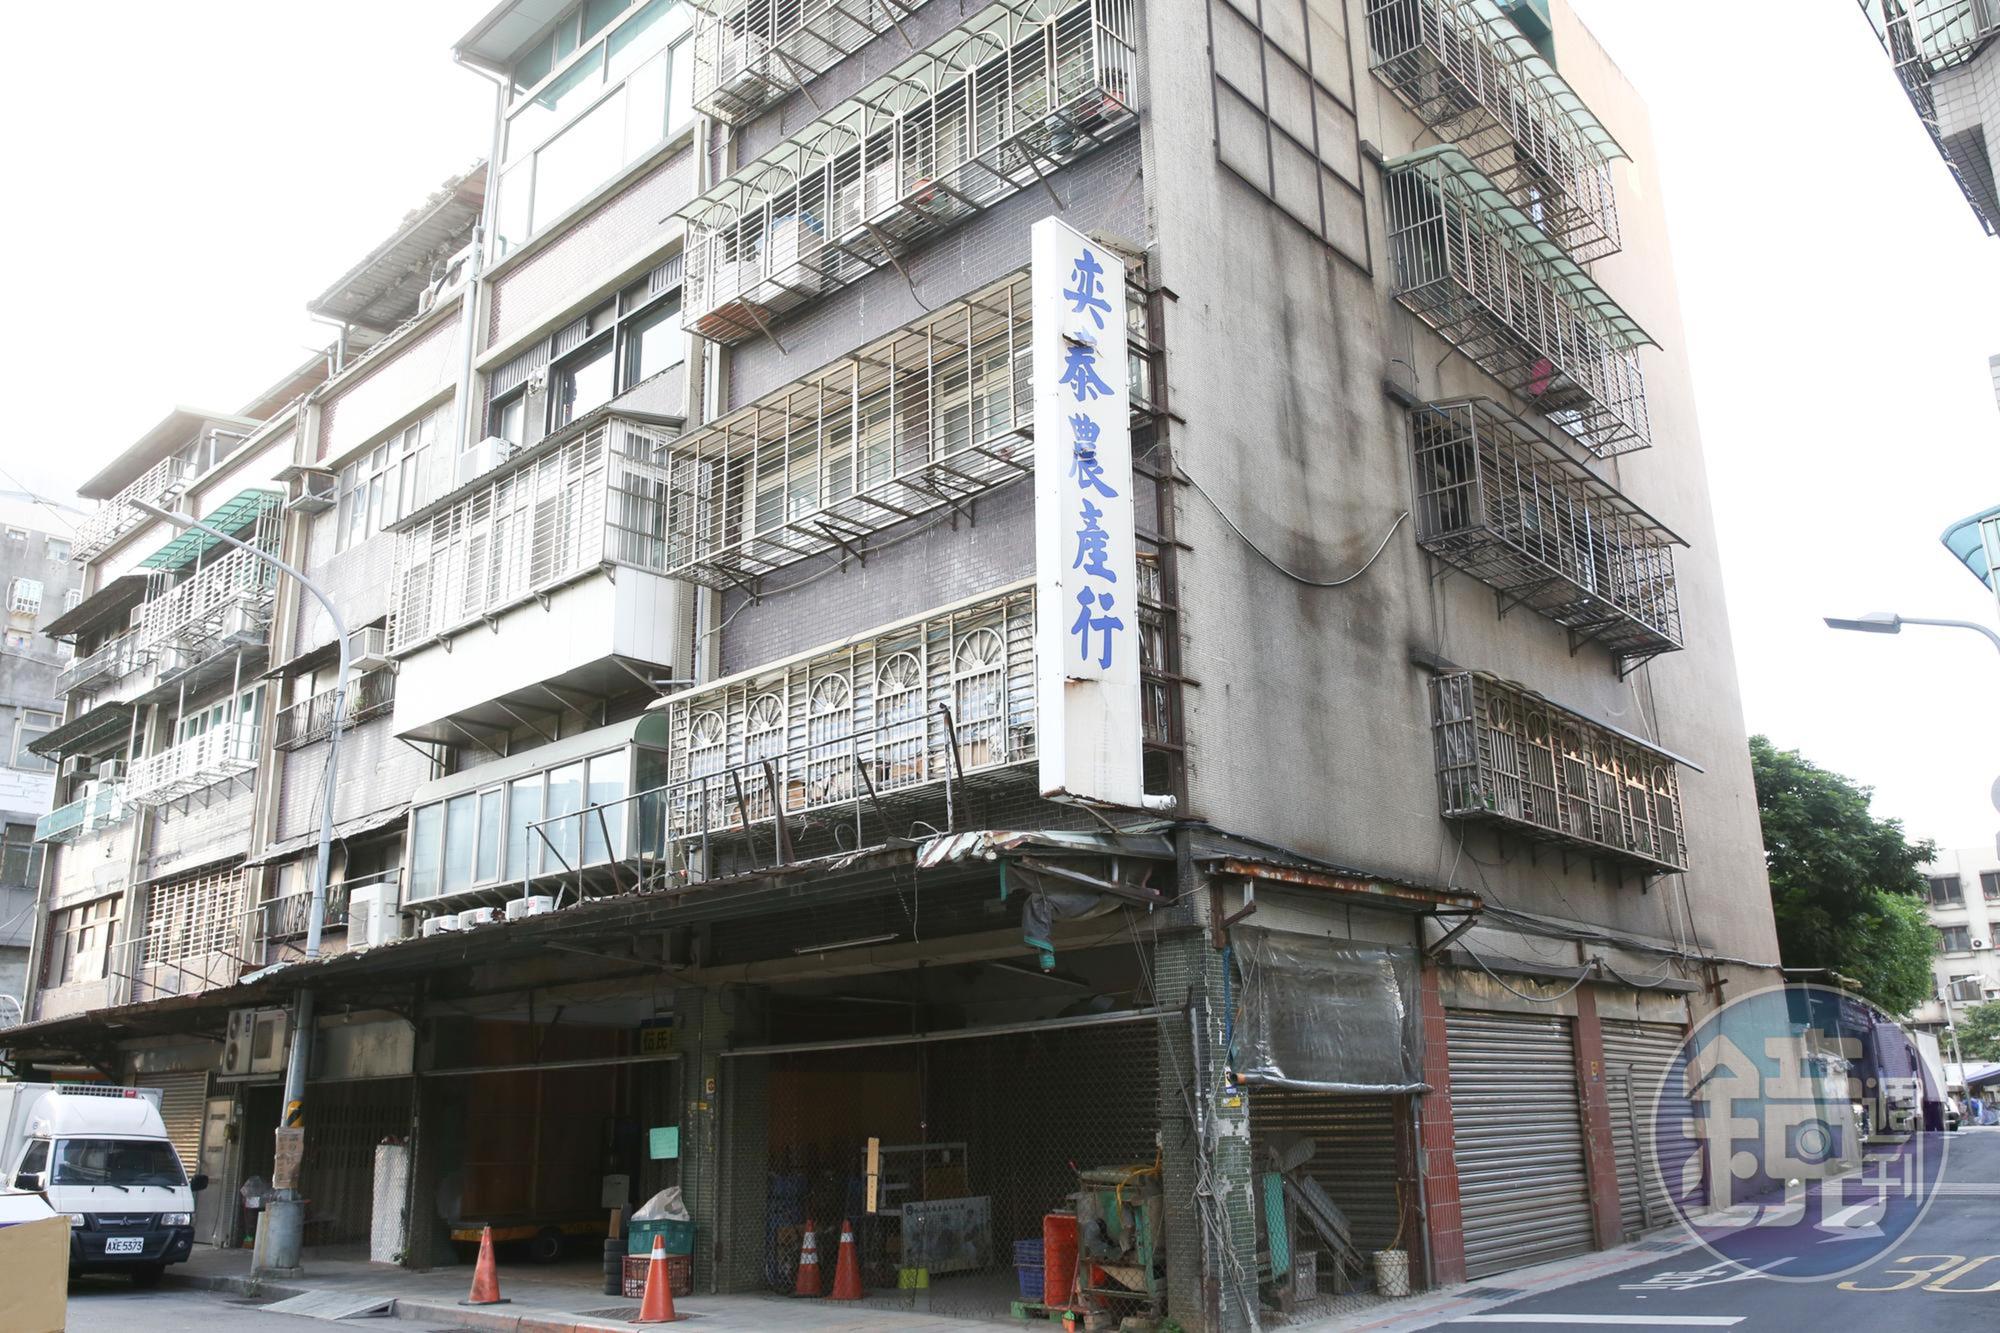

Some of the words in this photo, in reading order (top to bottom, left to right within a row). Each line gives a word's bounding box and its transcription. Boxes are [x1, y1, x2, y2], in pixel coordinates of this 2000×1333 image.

[1058, 248, 1124, 671] 奕泰農產行
